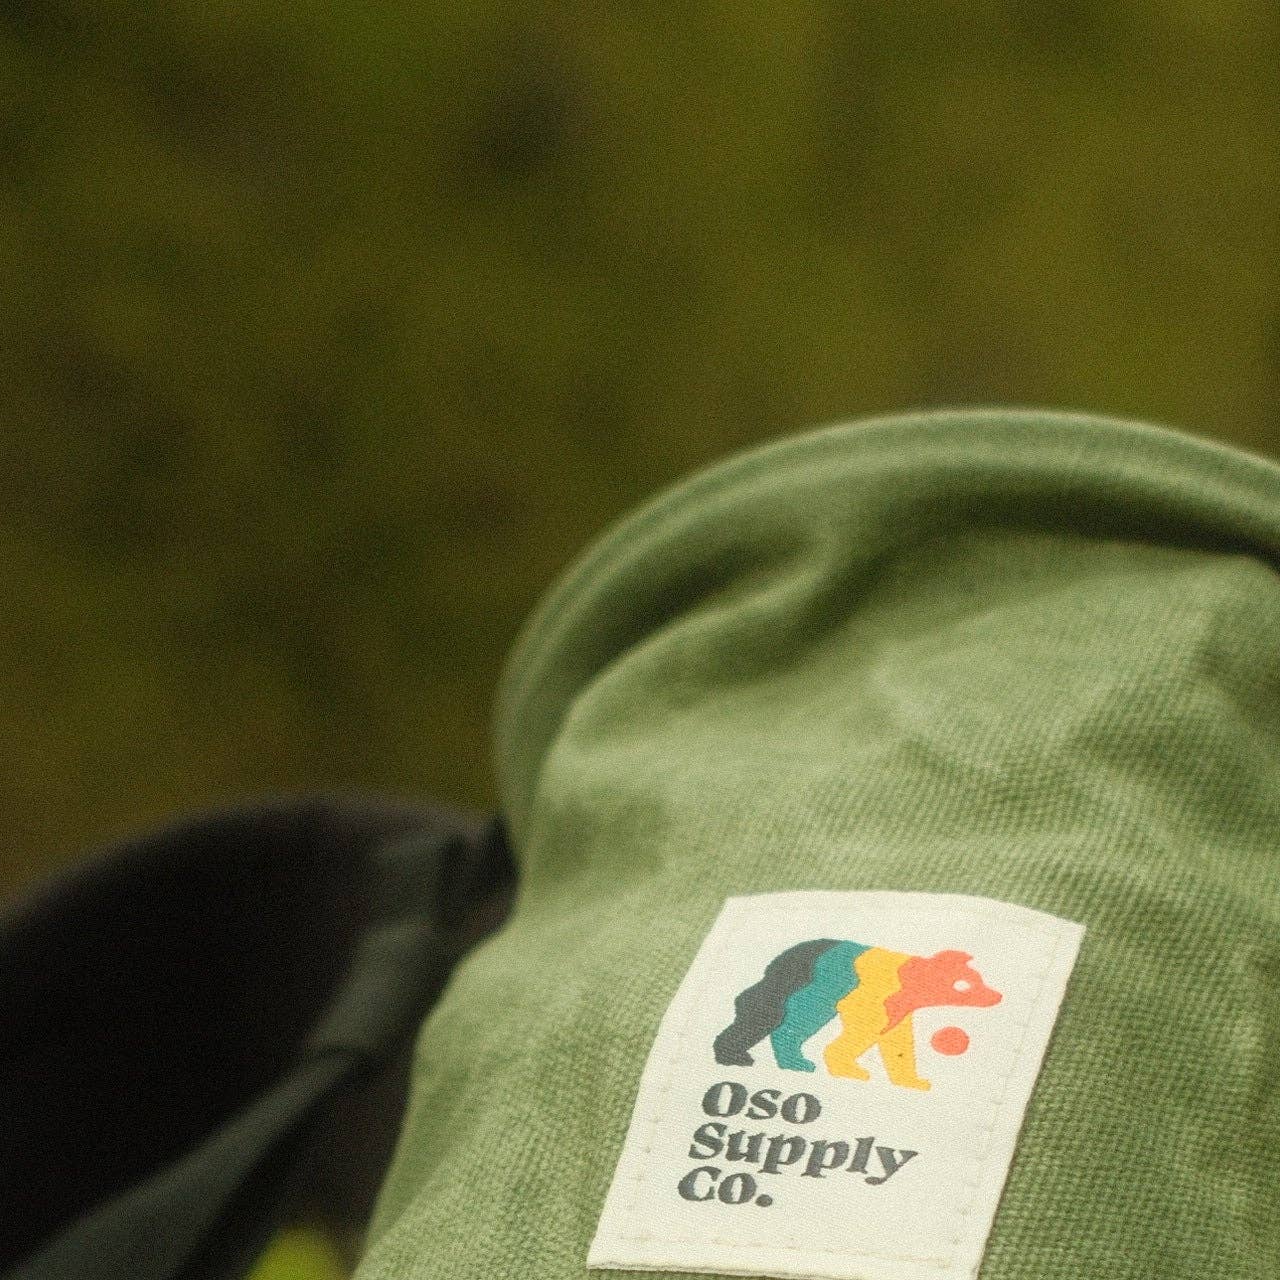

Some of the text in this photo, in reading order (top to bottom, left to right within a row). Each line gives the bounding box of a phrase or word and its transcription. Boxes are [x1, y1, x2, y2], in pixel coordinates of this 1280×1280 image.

[701, 1081, 822, 1125] Oso
[687, 1122, 919, 1186] Supply
[677, 1165, 773, 1207] Co.
